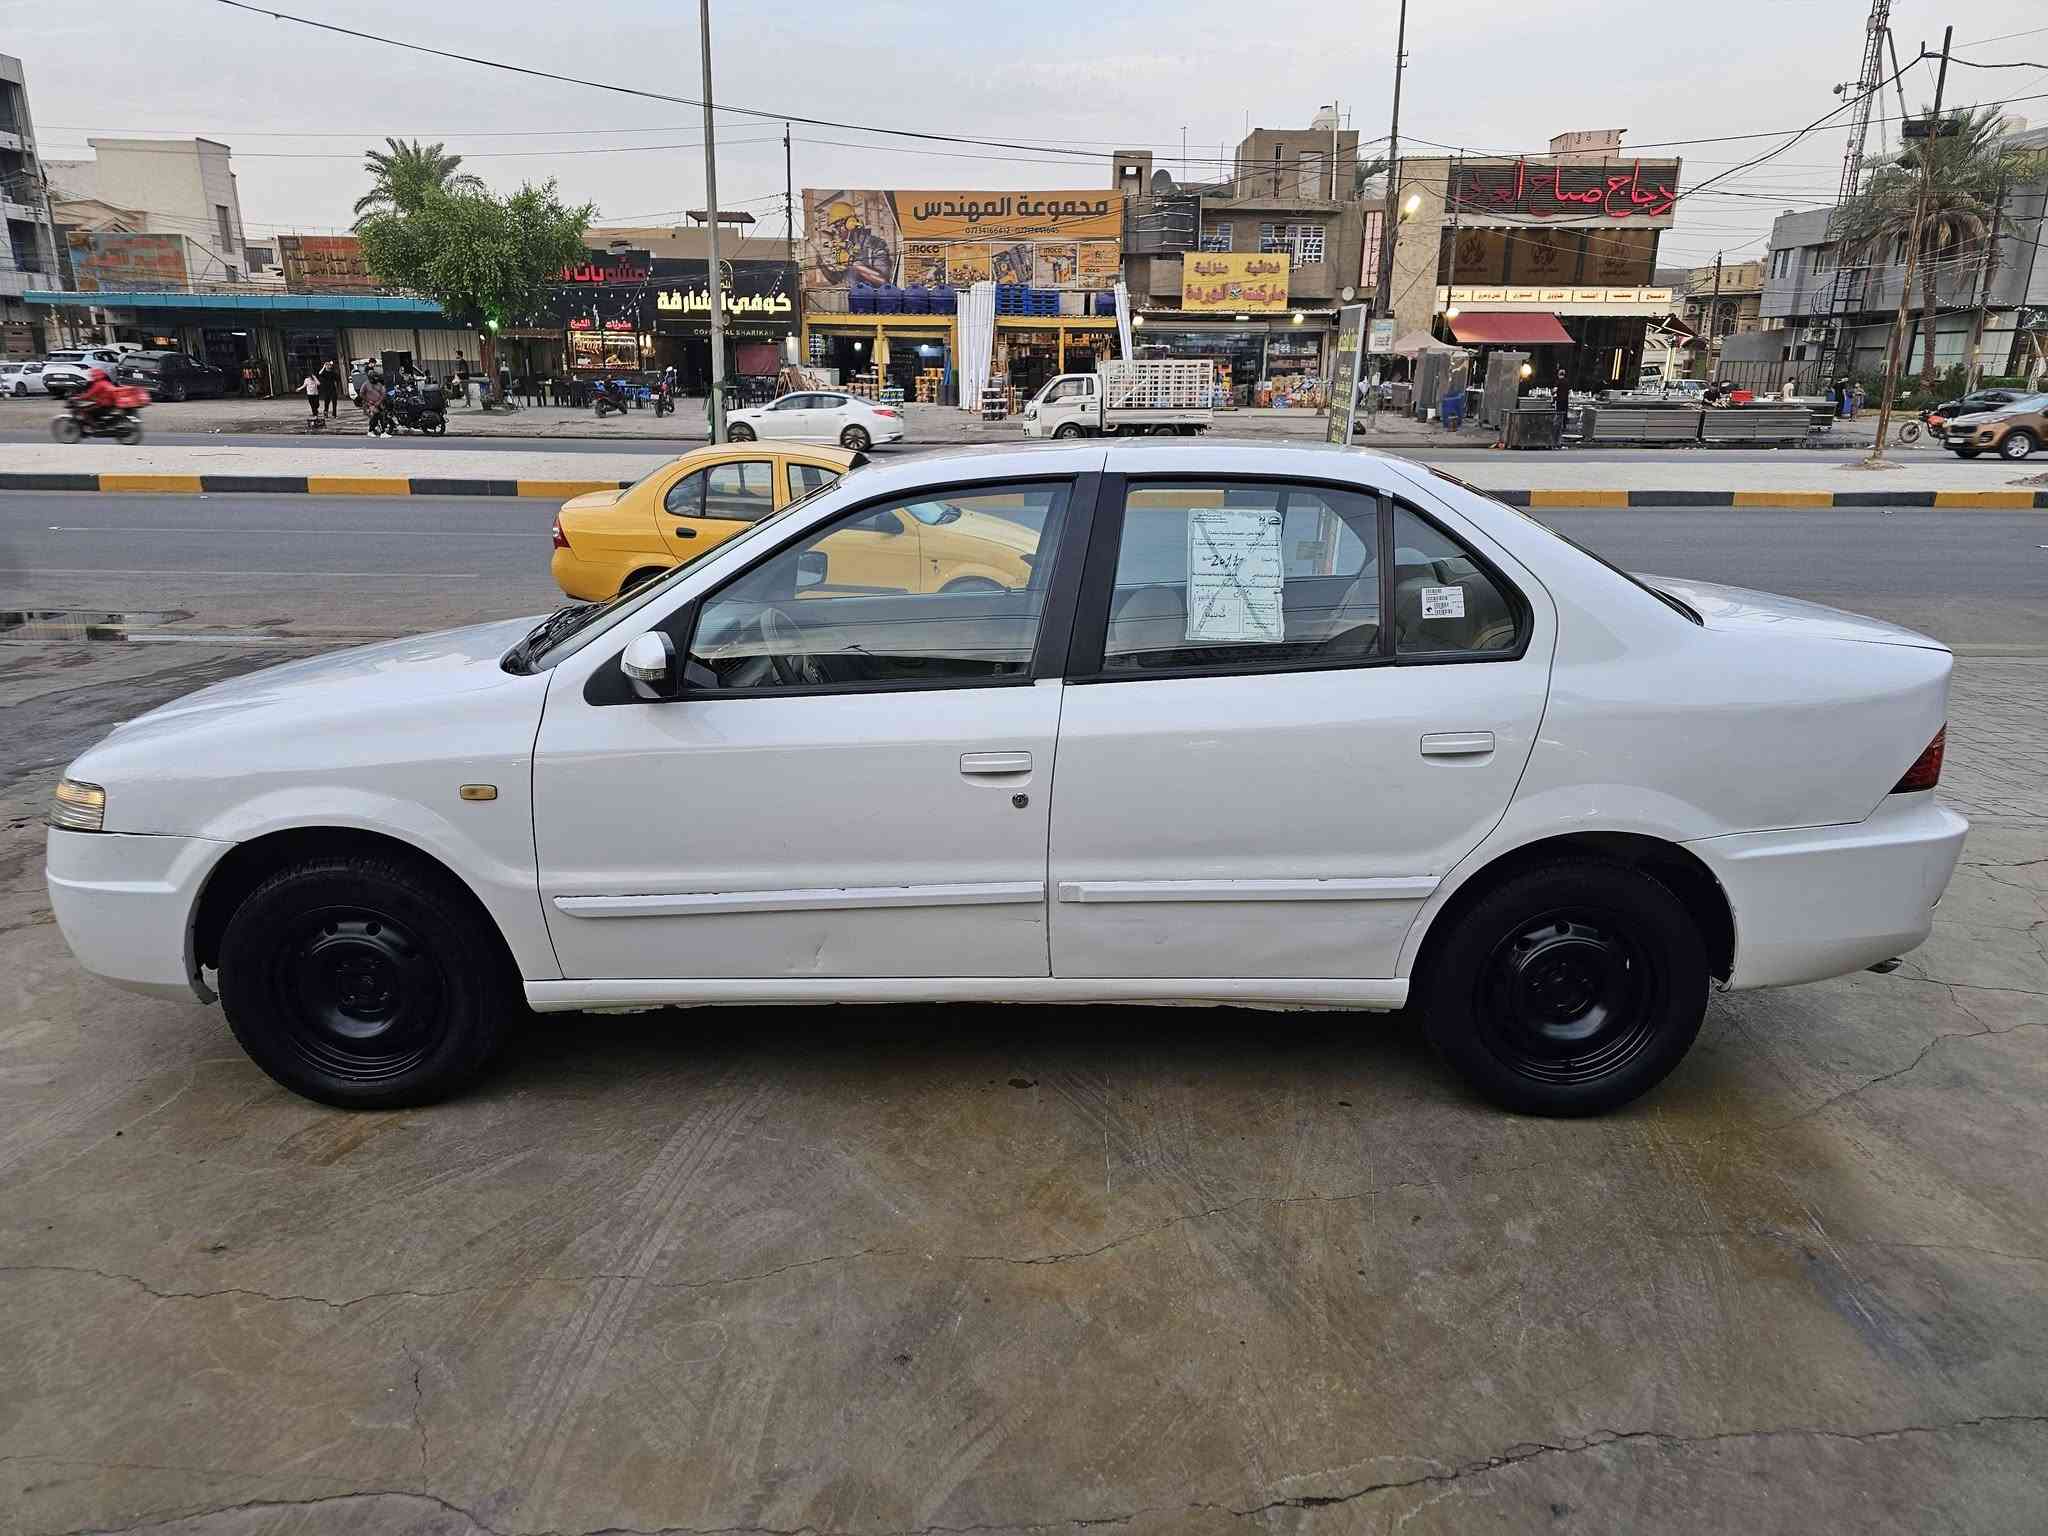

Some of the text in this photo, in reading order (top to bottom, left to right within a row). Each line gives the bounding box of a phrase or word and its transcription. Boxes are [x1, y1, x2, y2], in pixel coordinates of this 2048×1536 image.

[1604, 158, 1676, 217] دجاج
[913, 195, 1108, 223] مجموعة المهندس
[727, 291, 792, 315] كوفي
